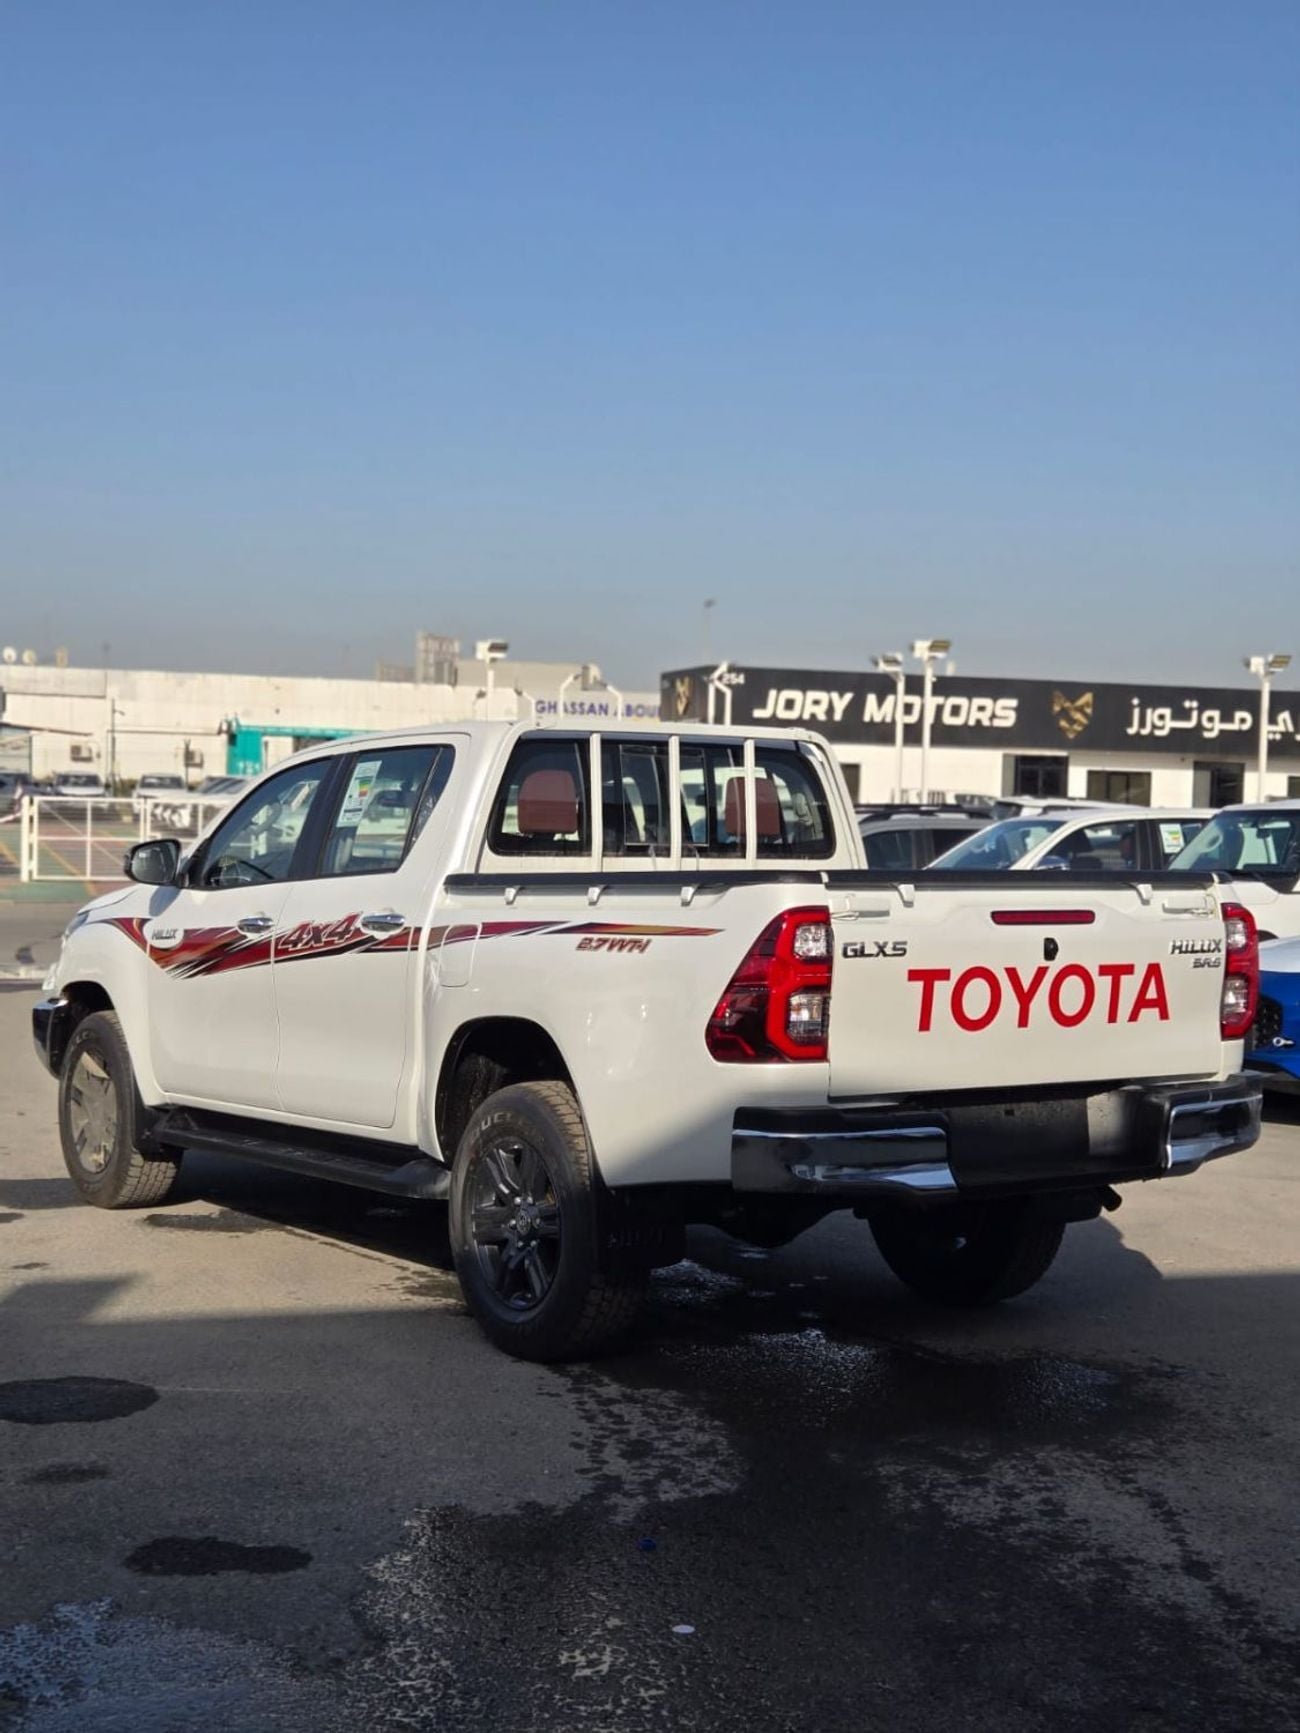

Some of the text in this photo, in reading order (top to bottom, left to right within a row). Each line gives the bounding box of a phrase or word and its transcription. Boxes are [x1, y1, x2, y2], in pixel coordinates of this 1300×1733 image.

[752, 689, 853, 722] JORY
[1126, 698, 1252, 738] موتورز
[1170, 939, 1222, 955] HILUX
[907, 962, 1170, 1032] TOYOTA
